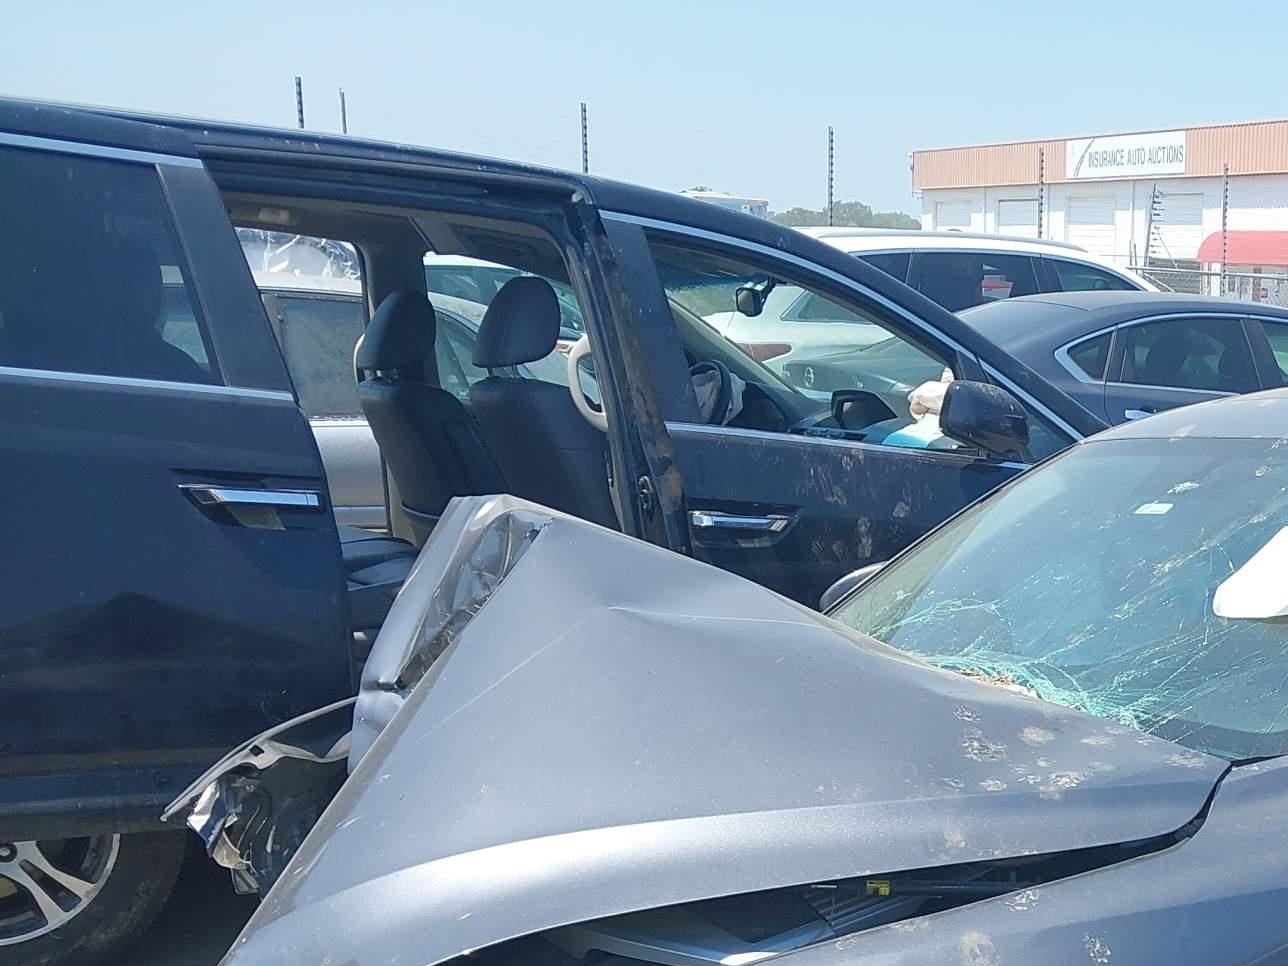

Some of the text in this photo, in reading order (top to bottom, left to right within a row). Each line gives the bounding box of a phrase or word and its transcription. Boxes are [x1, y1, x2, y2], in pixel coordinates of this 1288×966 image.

[1088, 145, 1184, 168] INSURANCE AUTO AUCTIONS
